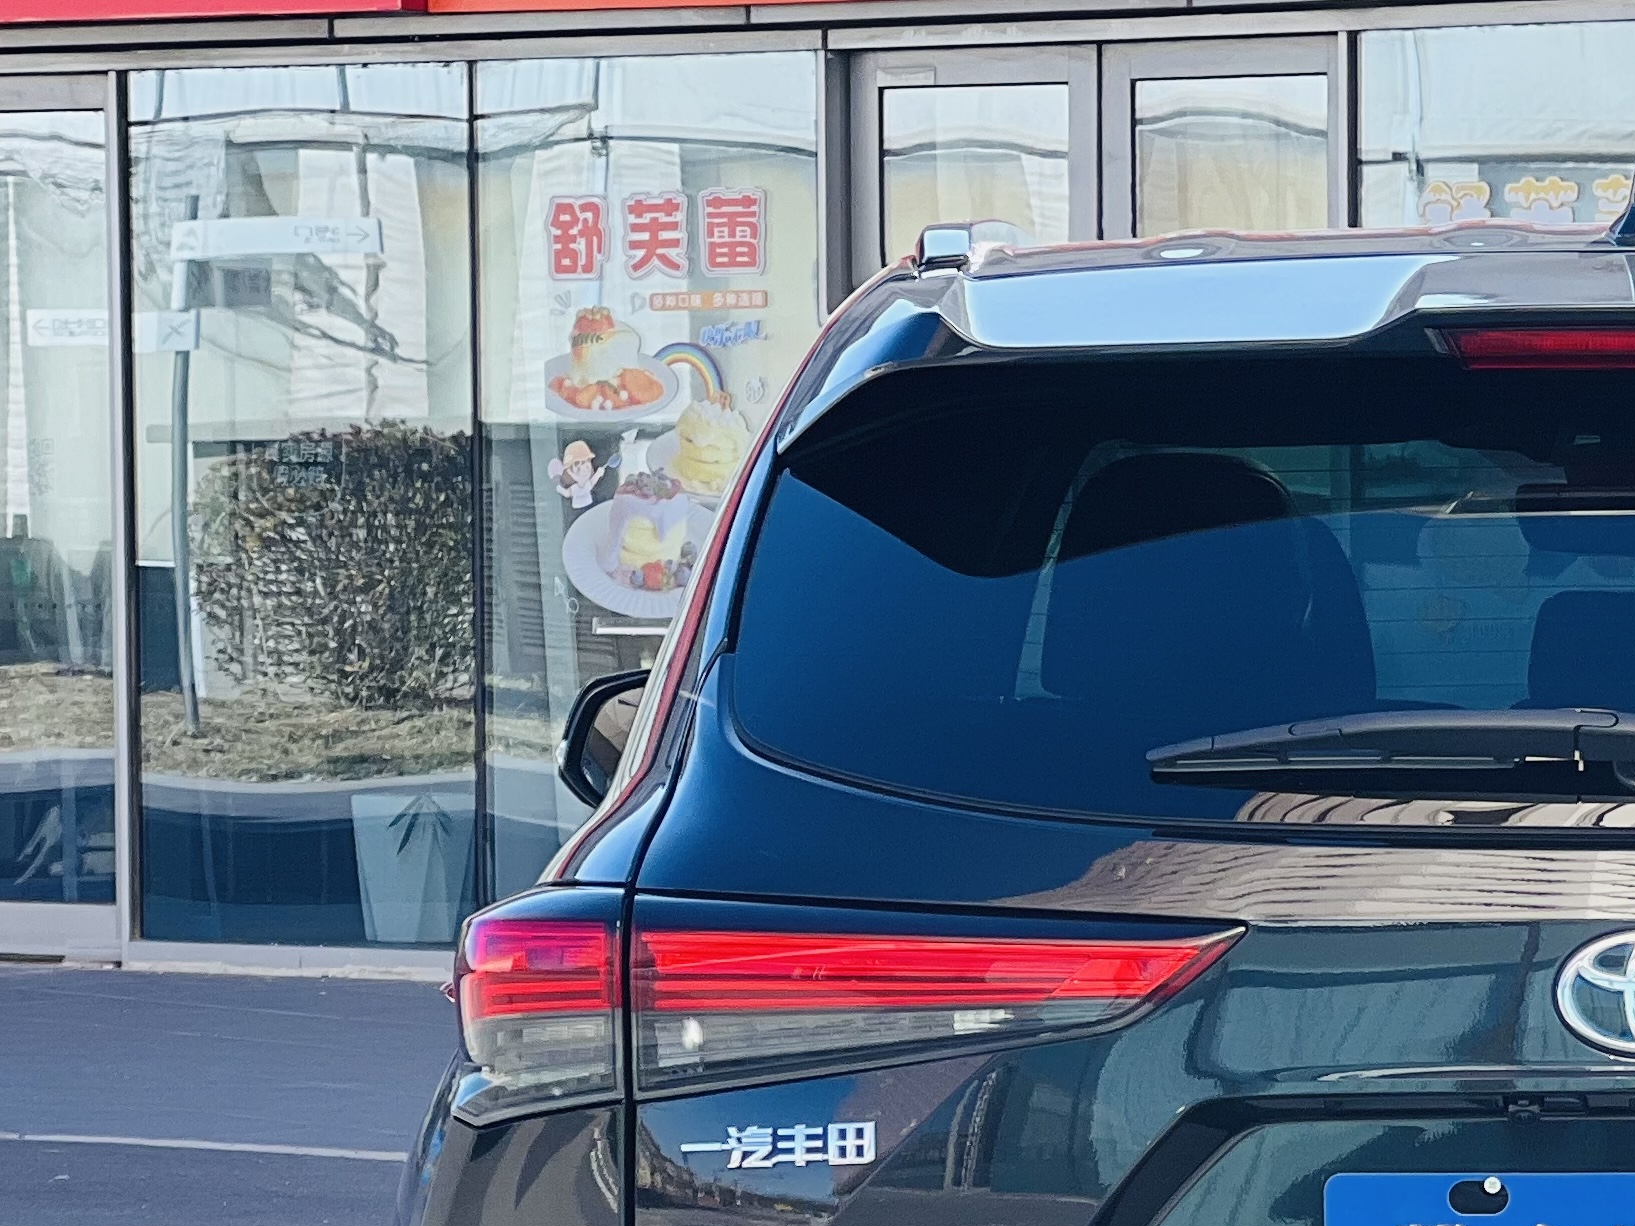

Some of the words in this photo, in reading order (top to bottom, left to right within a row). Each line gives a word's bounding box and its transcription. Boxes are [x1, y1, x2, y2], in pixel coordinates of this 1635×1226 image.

[547, 192, 764, 276] 舒芙蕾
[680, 1121, 876, 1169] 一汽丰田
